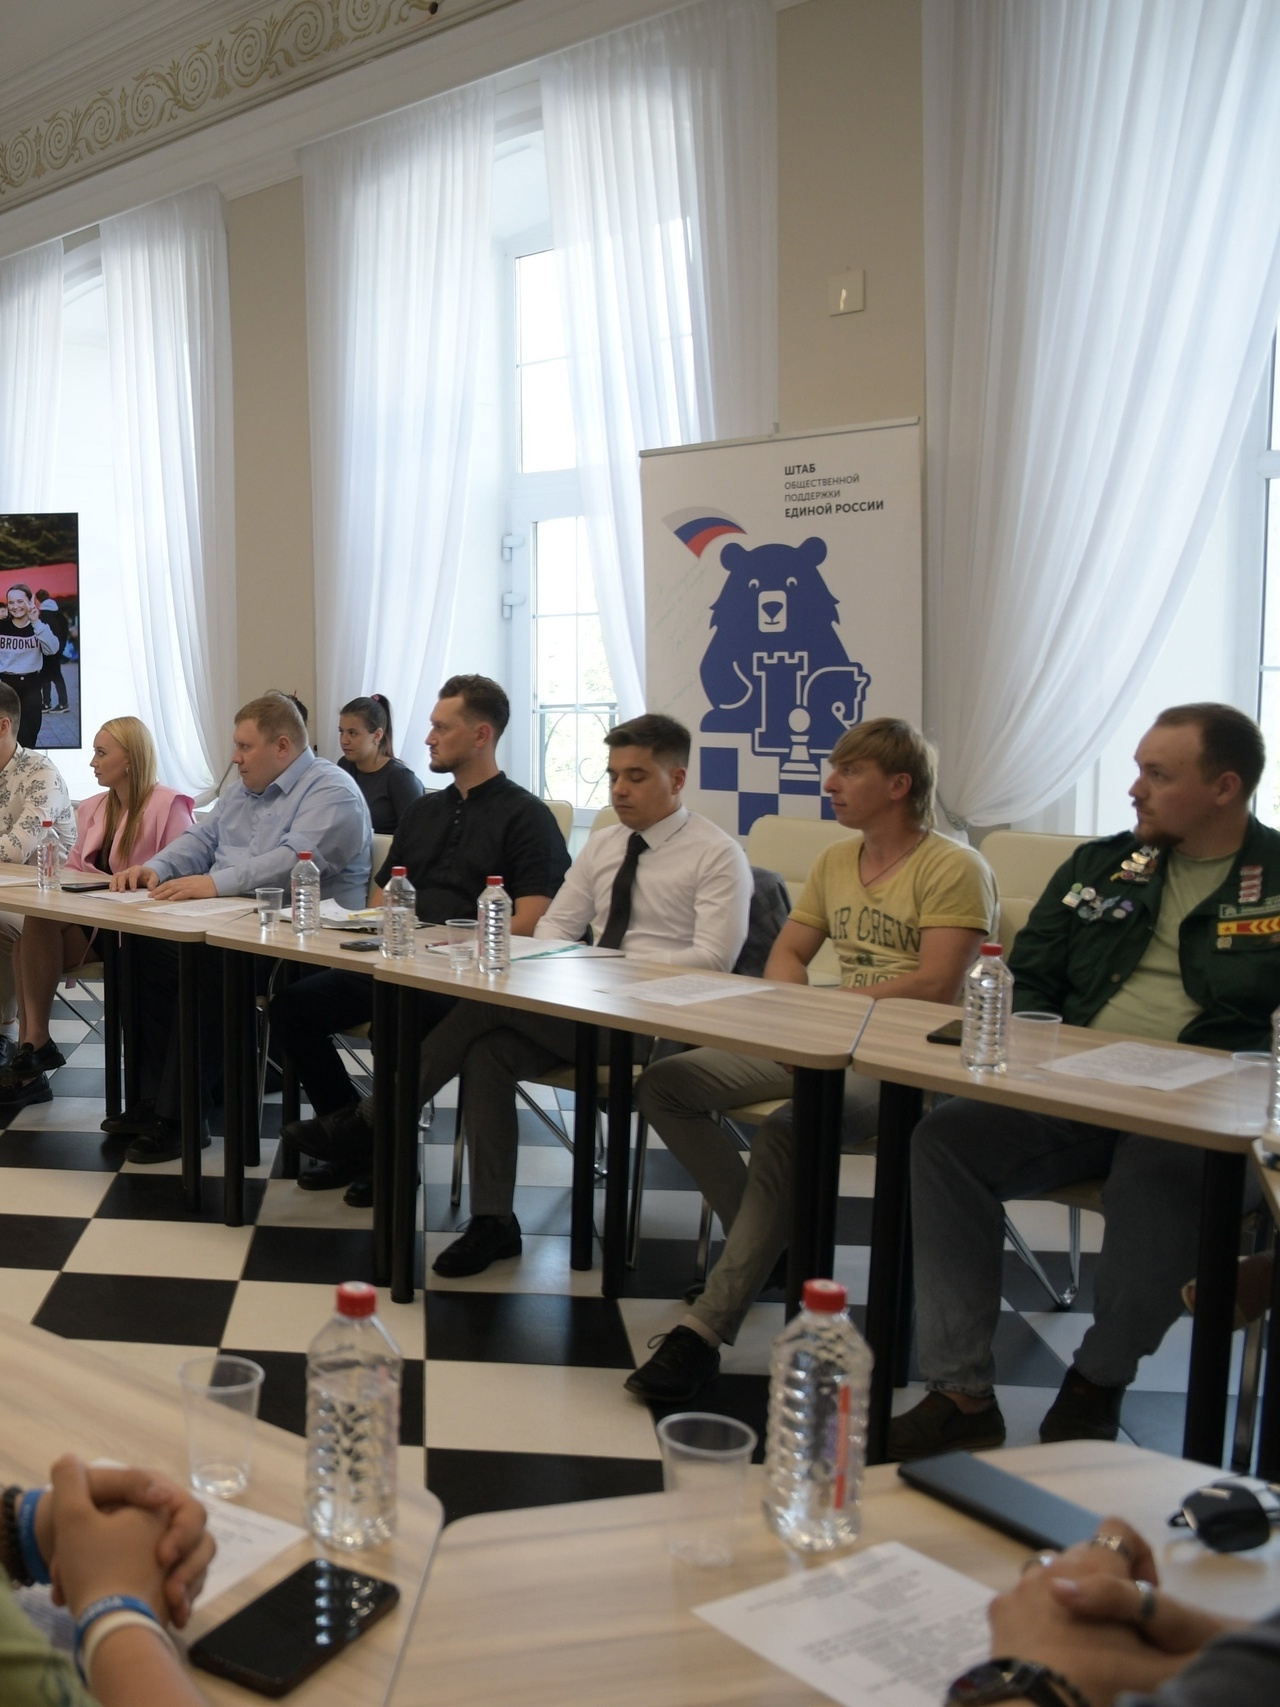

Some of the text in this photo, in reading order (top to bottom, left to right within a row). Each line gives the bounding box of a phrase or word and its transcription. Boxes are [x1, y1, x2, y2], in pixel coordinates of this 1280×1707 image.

[784, 463, 816, 476] ШТАБ
[784, 473, 860, 490] ОБЩЕСТВЕННОЙ
[784, 490, 841, 502] ПОДДЕРЖКИ
[785, 500, 884, 519] ЕДИНОЙ РОССИИ
[857, 905, 922, 953] CREW
